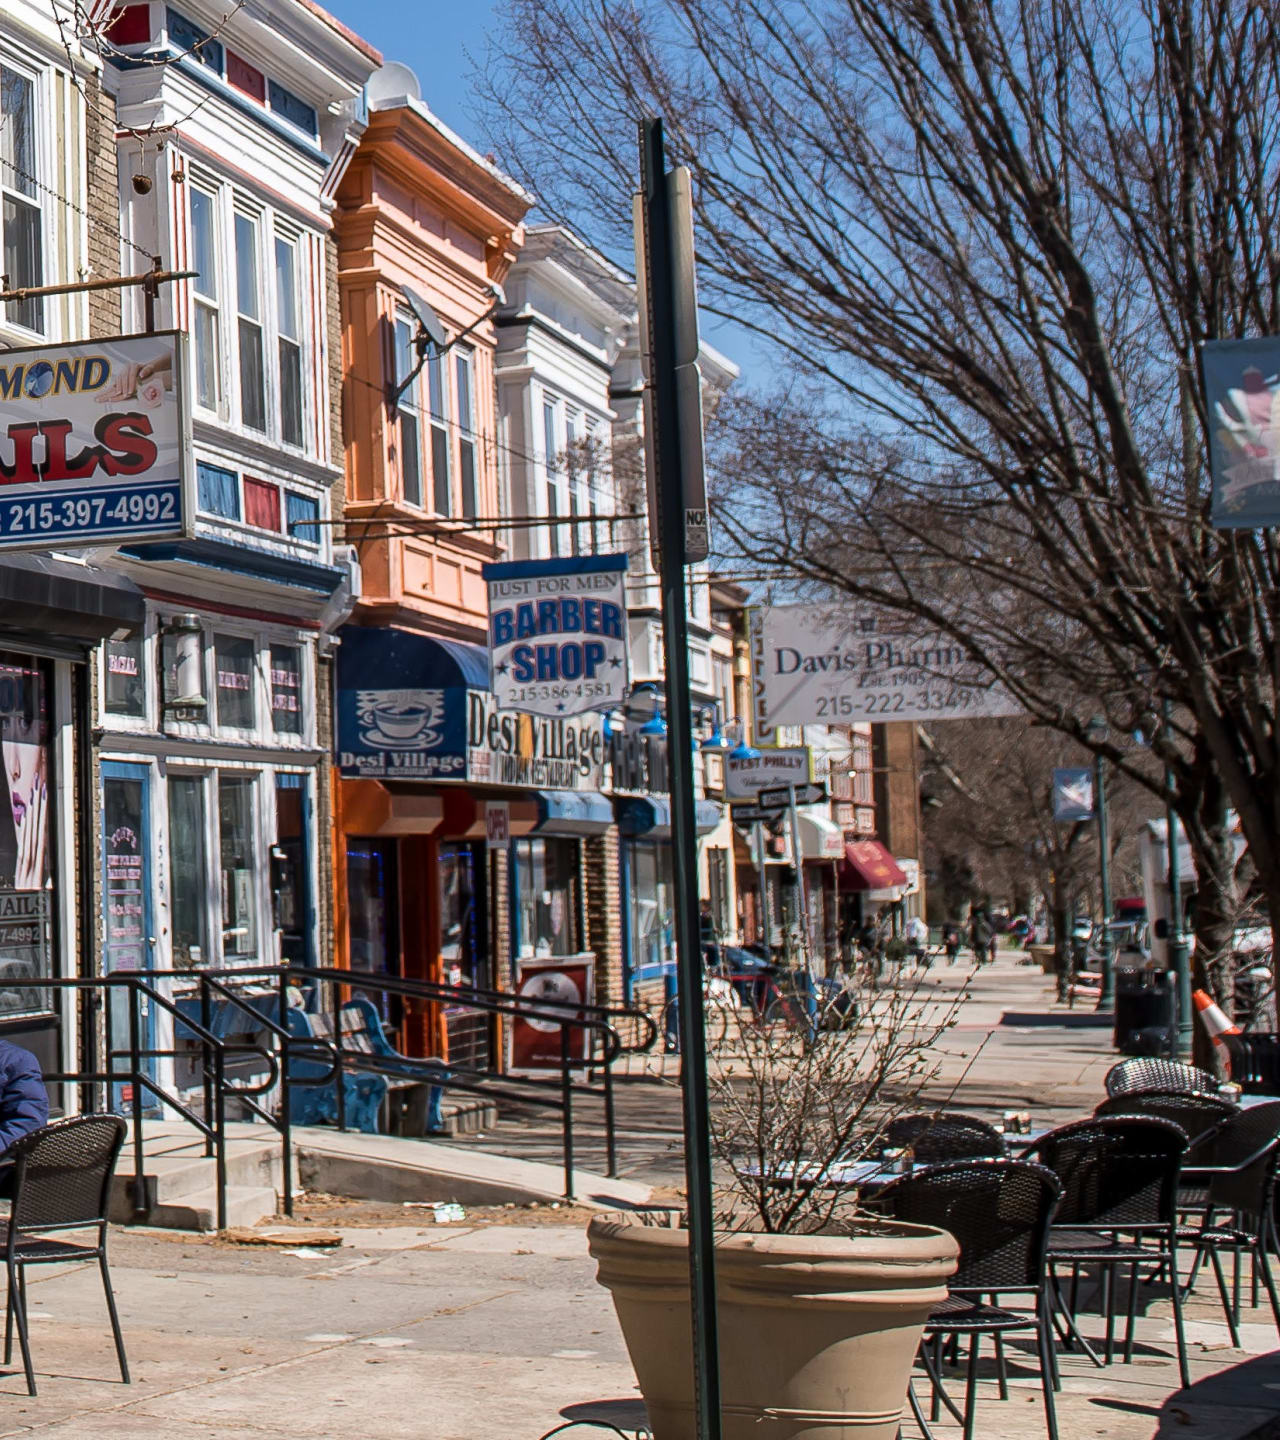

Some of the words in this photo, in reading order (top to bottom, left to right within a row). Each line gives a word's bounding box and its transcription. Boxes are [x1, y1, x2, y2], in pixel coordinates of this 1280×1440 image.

[9, 492, 176, 531] 215-397-4992
[493, 581, 531, 599] JUST
[536, 577, 570, 593] FOR
[576, 573, 618, 590] MEN
[492, 595, 623, 650] BARBER
[511, 640, 607, 684] SHOP
[774, 645, 856, 676] Davis
[468, 692, 521, 755] Desi
[341, 752, 385, 768] Desi
[391, 752, 464, 773] Village
